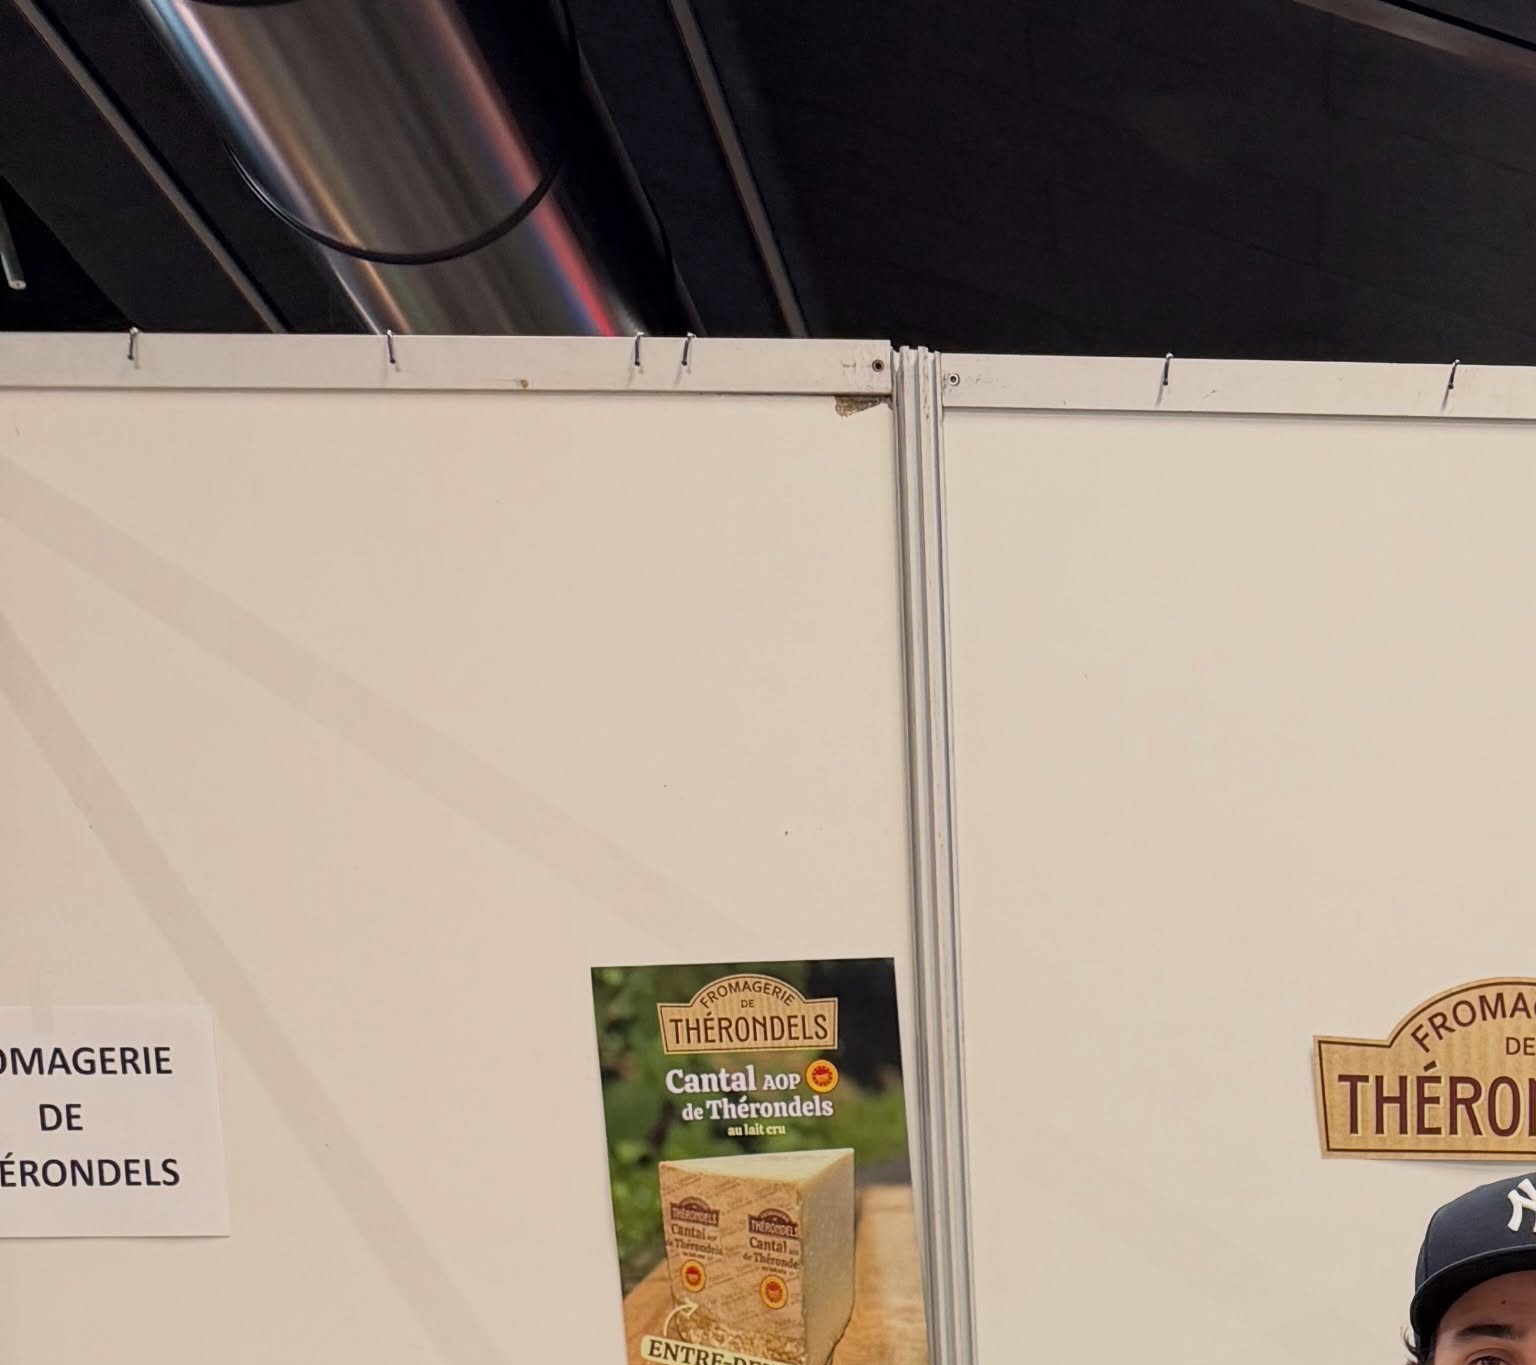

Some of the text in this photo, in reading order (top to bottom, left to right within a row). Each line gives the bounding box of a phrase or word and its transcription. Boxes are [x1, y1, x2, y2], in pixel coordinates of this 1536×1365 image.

[700, 980, 796, 1009] FROMAGERIE
[741, 999, 755, 1008] DE
[669, 1011, 828, 1045] THÉRONDELS
[1505, 1036, 1535, 1056] DE
[0, 1047, 173, 1076] MAGERIE
[665, 1064, 801, 1094] Cantal AOP
[39, 1104, 83, 1131] DE
[682, 1095, 834, 1120] de Thérondels
[727, 1123, 786, 1136] au lait cru
